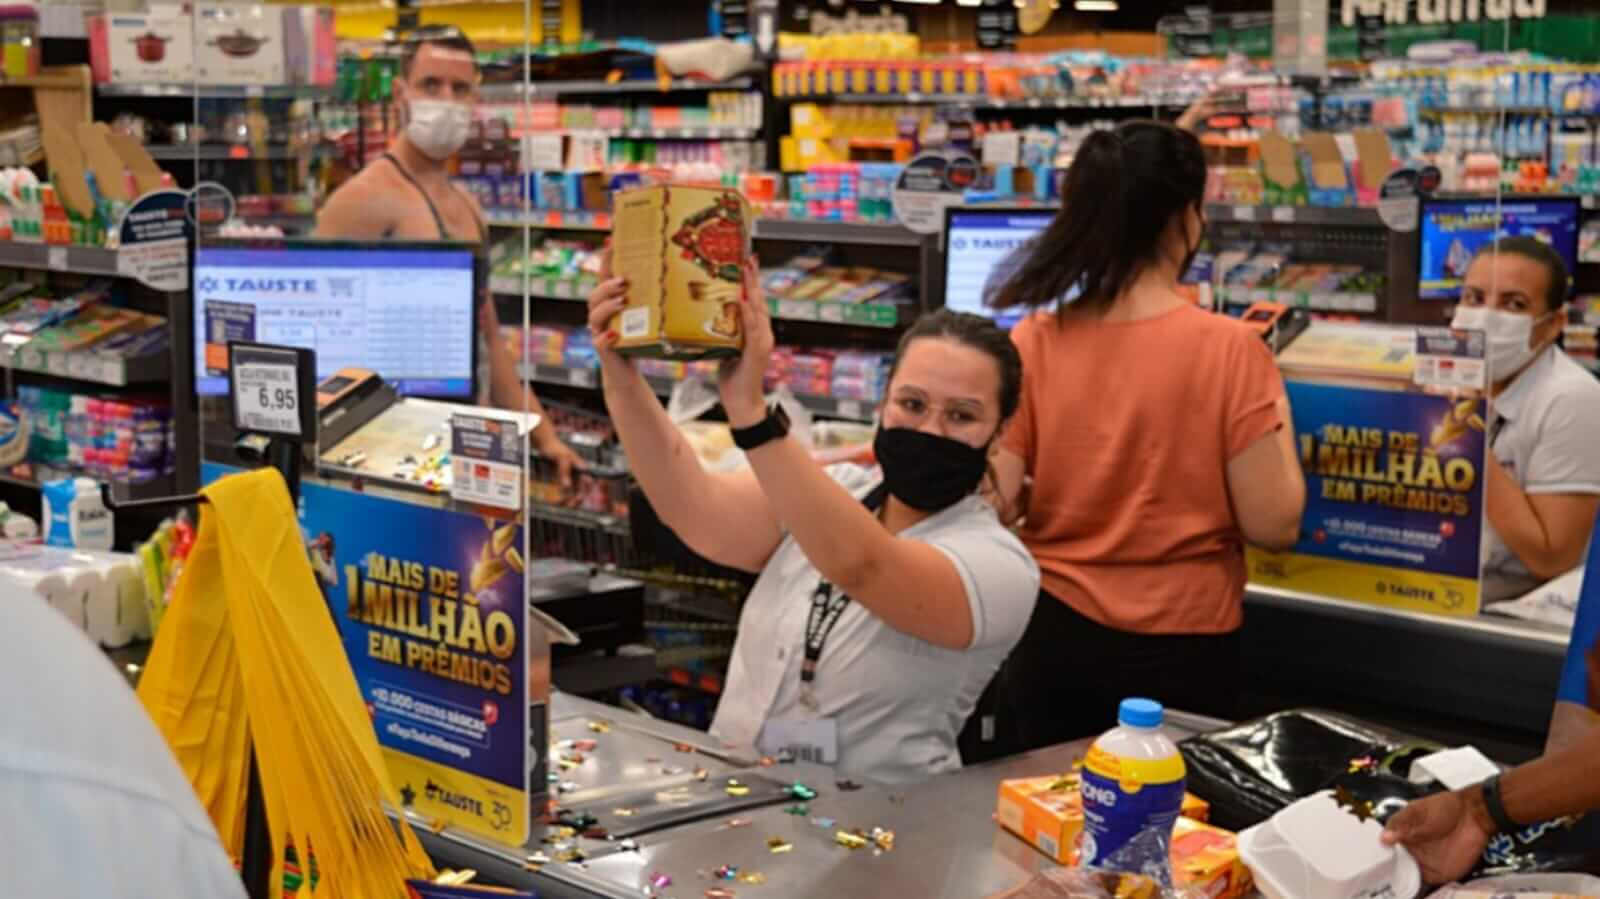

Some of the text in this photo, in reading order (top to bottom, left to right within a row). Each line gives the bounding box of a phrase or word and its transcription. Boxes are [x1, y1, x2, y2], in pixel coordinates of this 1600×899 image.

[226, 279, 317, 292] TAUSTE
[259, 387, 296, 411] 6,95
[1322, 424, 1420, 453] MAIS DE
[1319, 444, 1475, 492] MILHÃO
[1321, 479, 1469, 516] EM PRÊMIOS
[367, 552, 460, 597] MAIS DE
[344, 564, 516, 660] 1 MILHÃO
[368, 631, 513, 696] EM PRÊMIOS
[437, 786, 484, 817] TAUSTE
